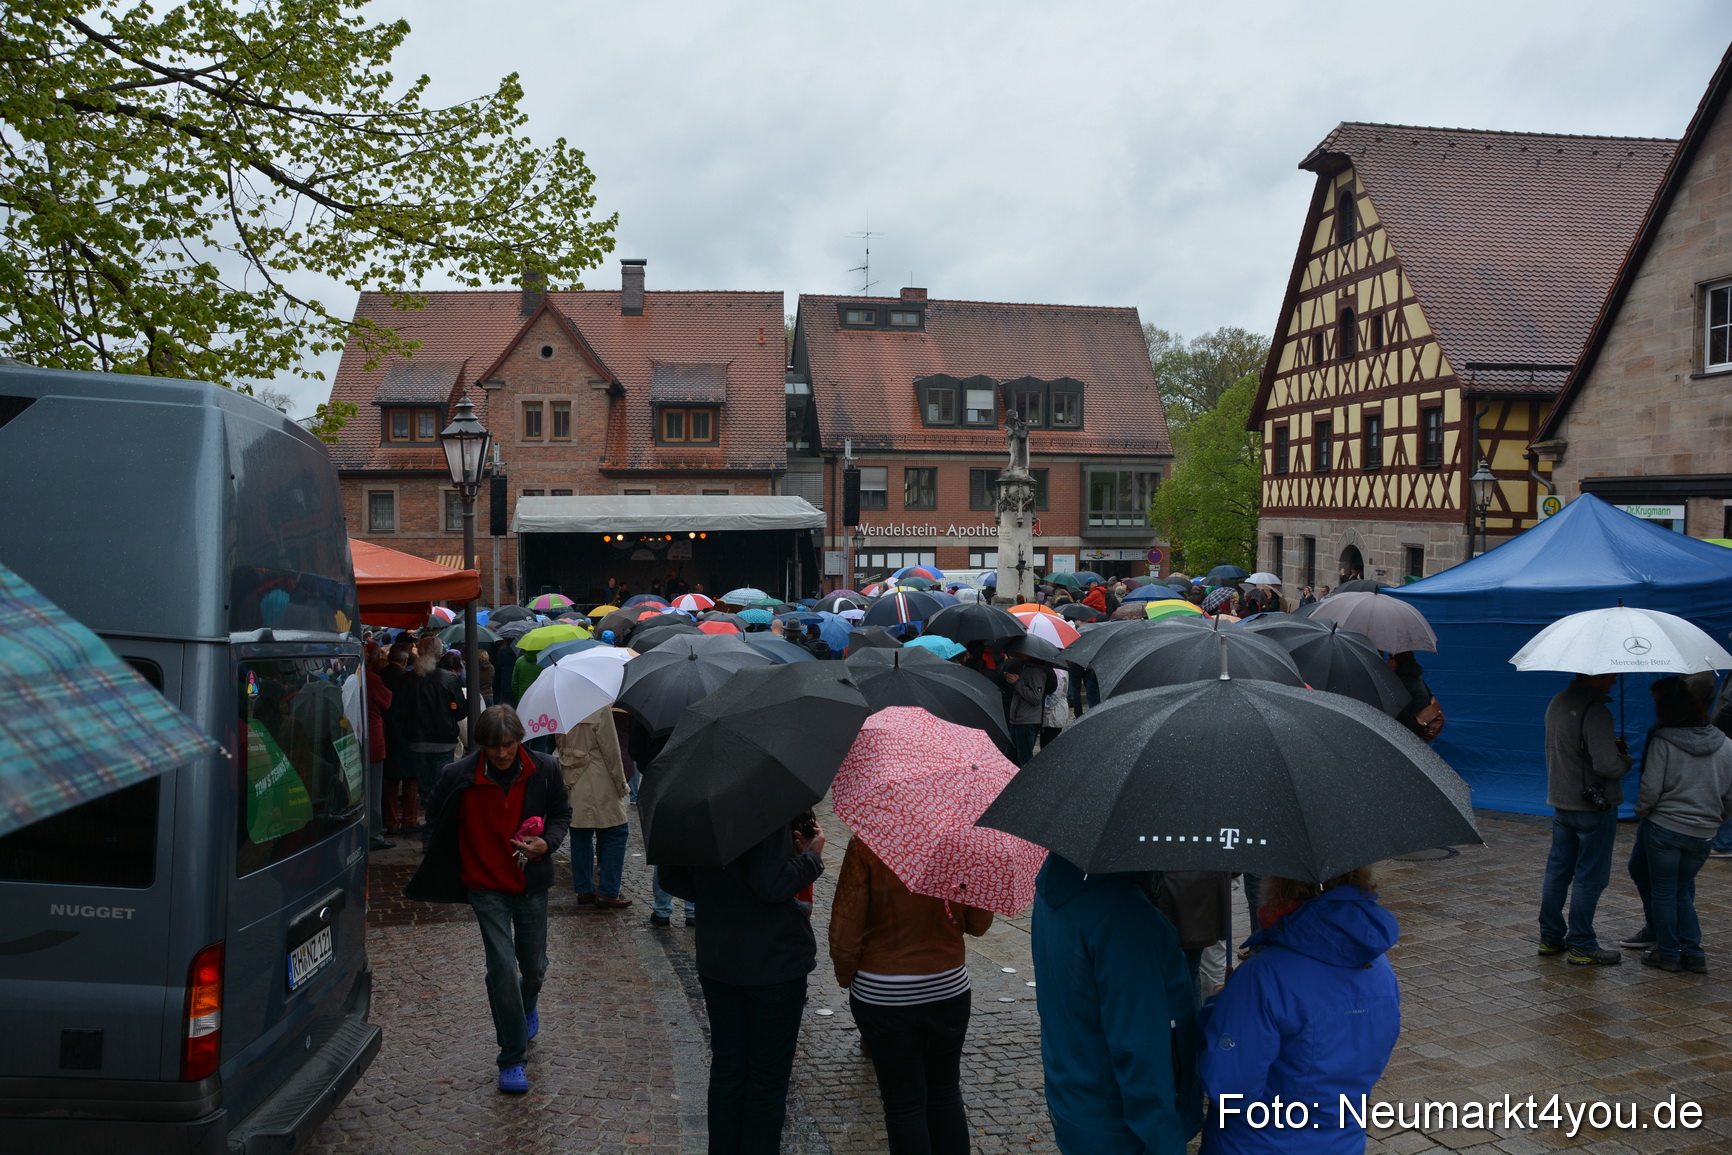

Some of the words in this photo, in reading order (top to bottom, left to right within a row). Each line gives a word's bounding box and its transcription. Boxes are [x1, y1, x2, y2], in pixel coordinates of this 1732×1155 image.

[855, 523, 937, 537] Wendelstein
[946, 523, 1000, 538] Apothe
[1219, 828, 1240, 850] T
[50, 903, 136, 920] NUGGET
[292, 949, 303, 979] RH
[318, 930, 332, 958] 121
